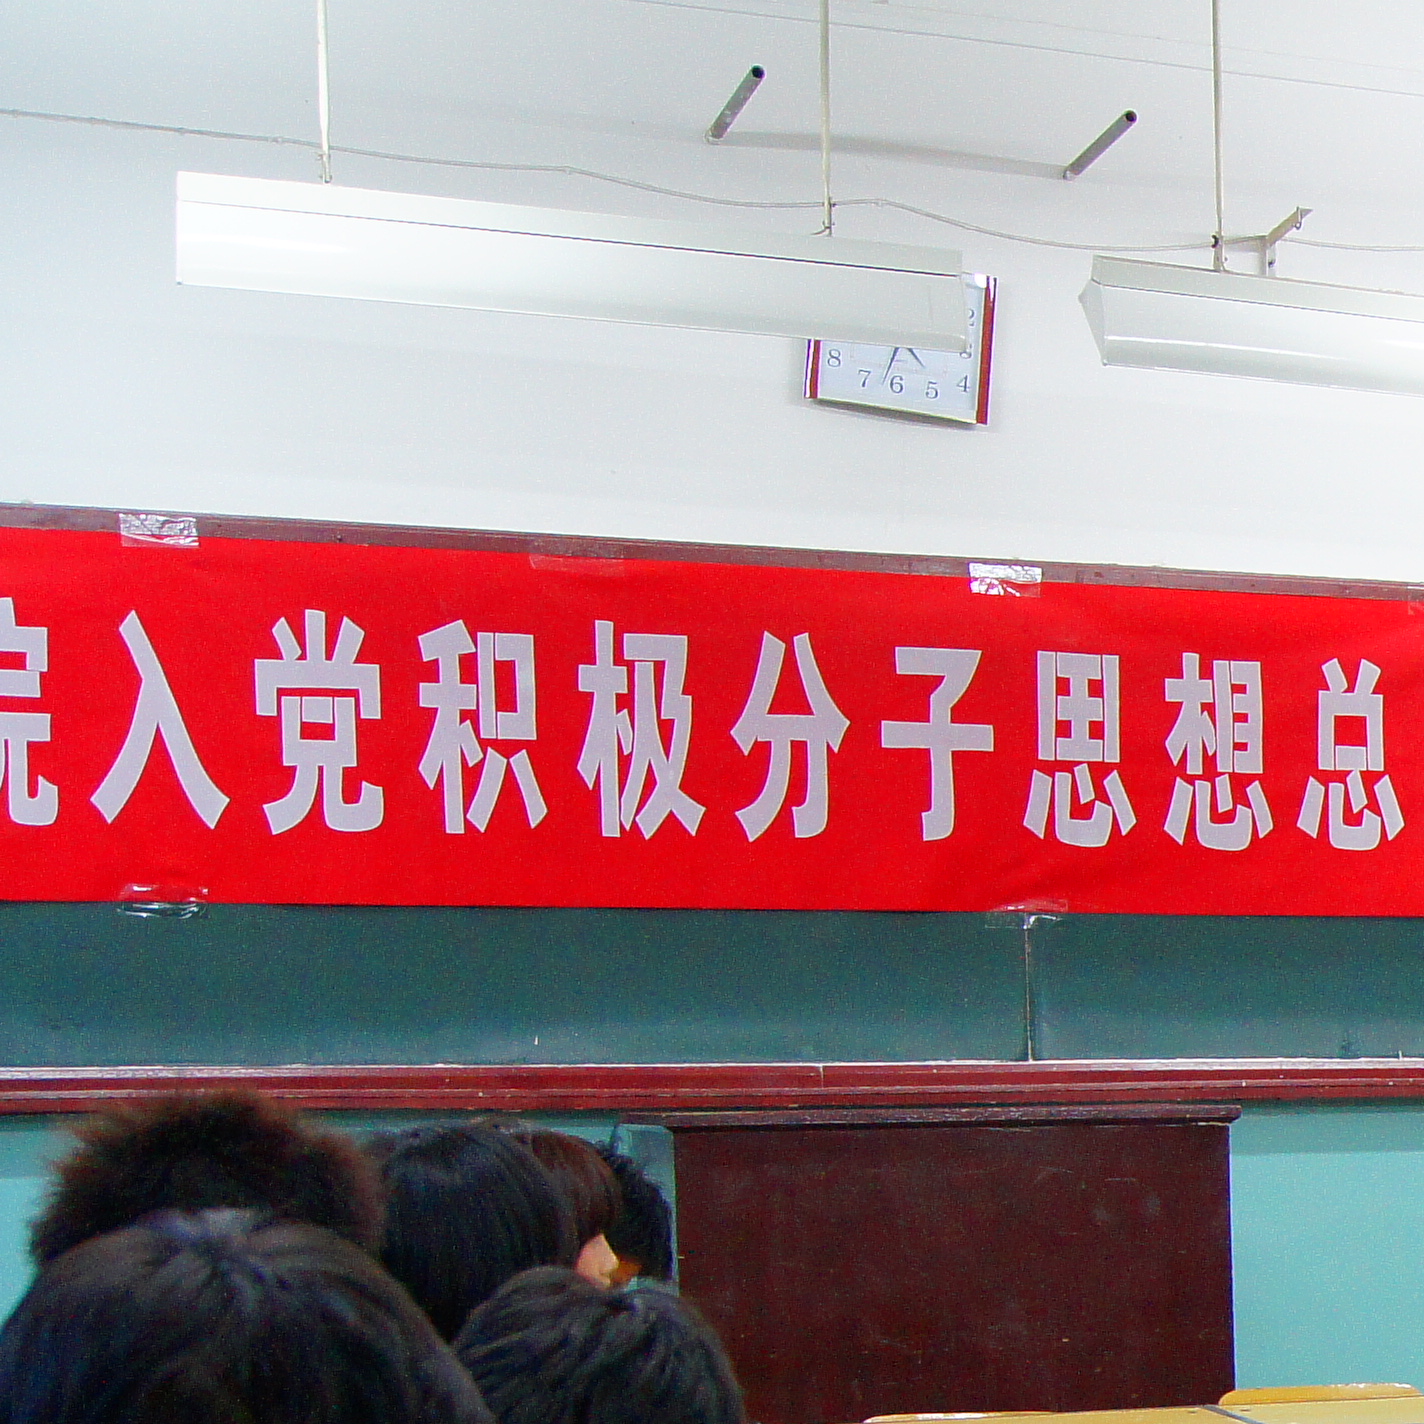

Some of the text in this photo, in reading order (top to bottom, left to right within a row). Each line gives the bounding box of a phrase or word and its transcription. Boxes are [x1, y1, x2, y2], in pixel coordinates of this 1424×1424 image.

[827, 349, 841, 367] 8
[858, 369, 970, 399] 7 6 5 4
